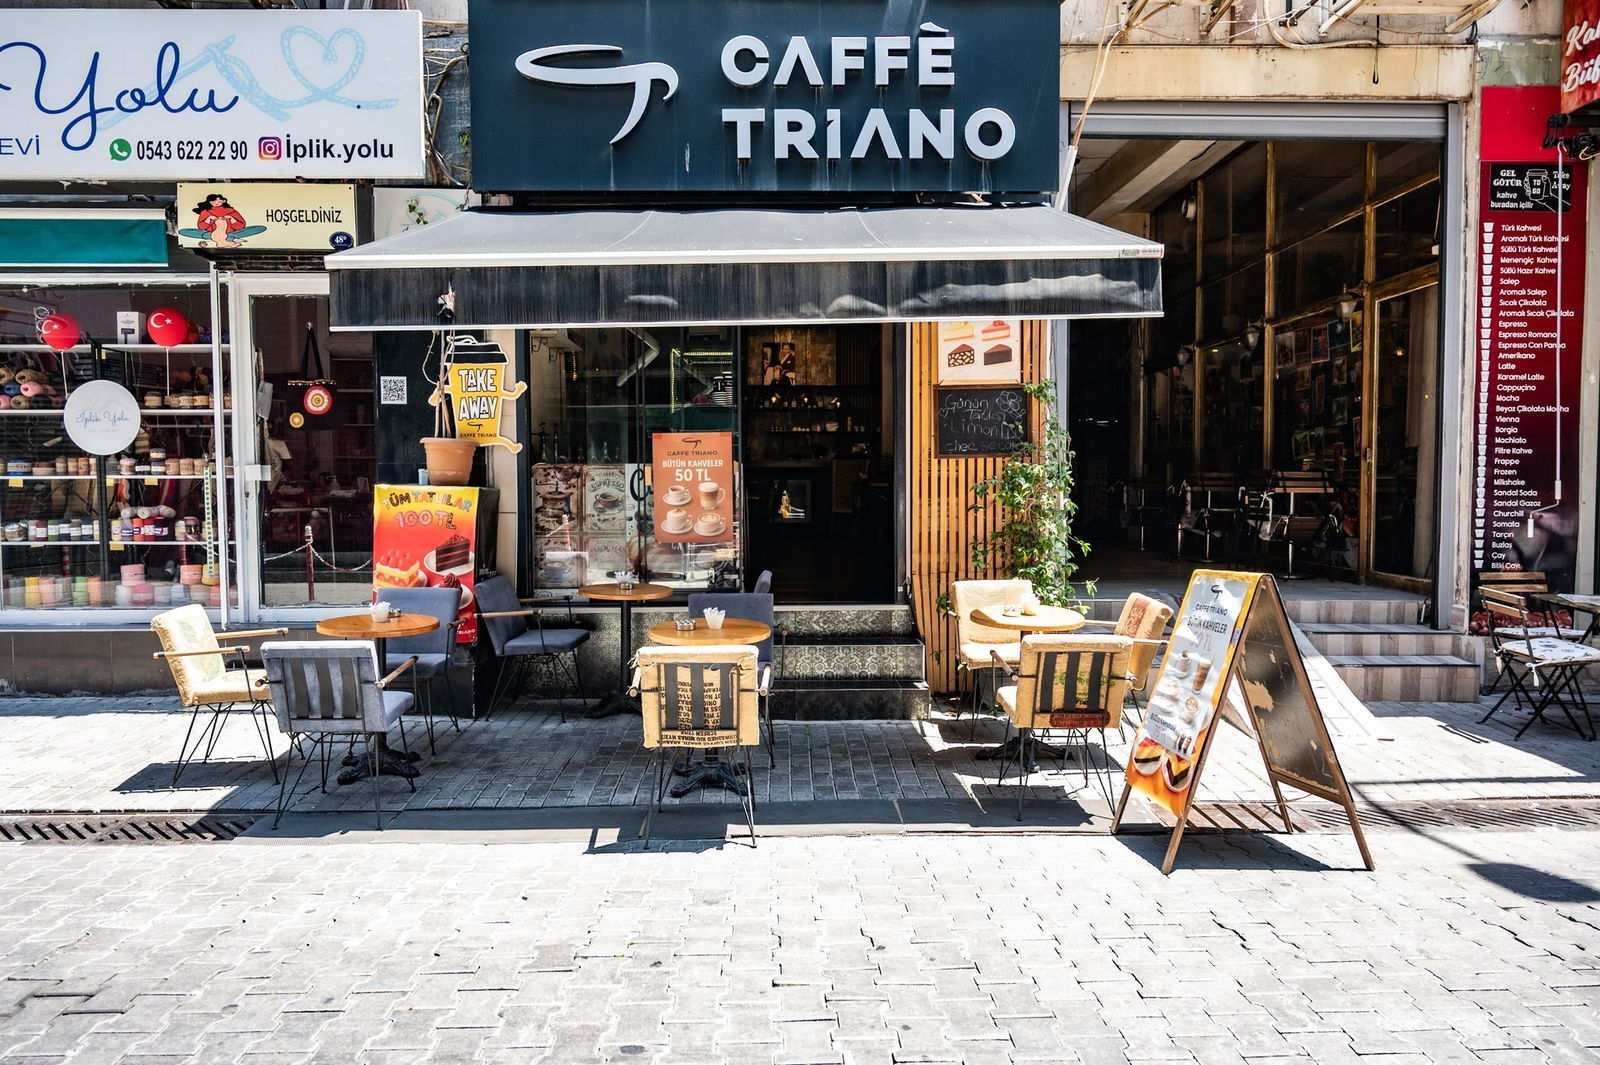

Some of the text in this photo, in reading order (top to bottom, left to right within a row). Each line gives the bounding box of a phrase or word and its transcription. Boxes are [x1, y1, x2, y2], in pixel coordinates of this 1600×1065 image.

[720, 21, 956, 88] CAFFÈ
[0, 41, 239, 151] Yolu
[721, 107, 1017, 161] TRIANO
[136, 140, 248, 161] 0543 622 22 90
[286, 134, 394, 163] İplik.yolu
[1500, 169, 1516, 177] GEL
[1493, 178, 1522, 187] GÖTÜR
[1490, 200, 1518, 208] buradan
[1496, 191, 1518, 199] kahve
[266, 208, 342, 226] HOŞGELDİNİZ
[1500, 278, 1519, 286] Salep
[457, 368, 498, 393] TAKE
[458, 396, 499, 421] AWAY
[662, 458, 724, 468] BÜTÜN KAHVELER
[1495, 458, 1519, 466] Frappe
[675, 469, 712, 482] 50 TL
[381, 490, 473, 513] TÜM TATLILAR
[394, 509, 457, 530] 100 TL
[1493, 531, 1514, 539] Tarçın
